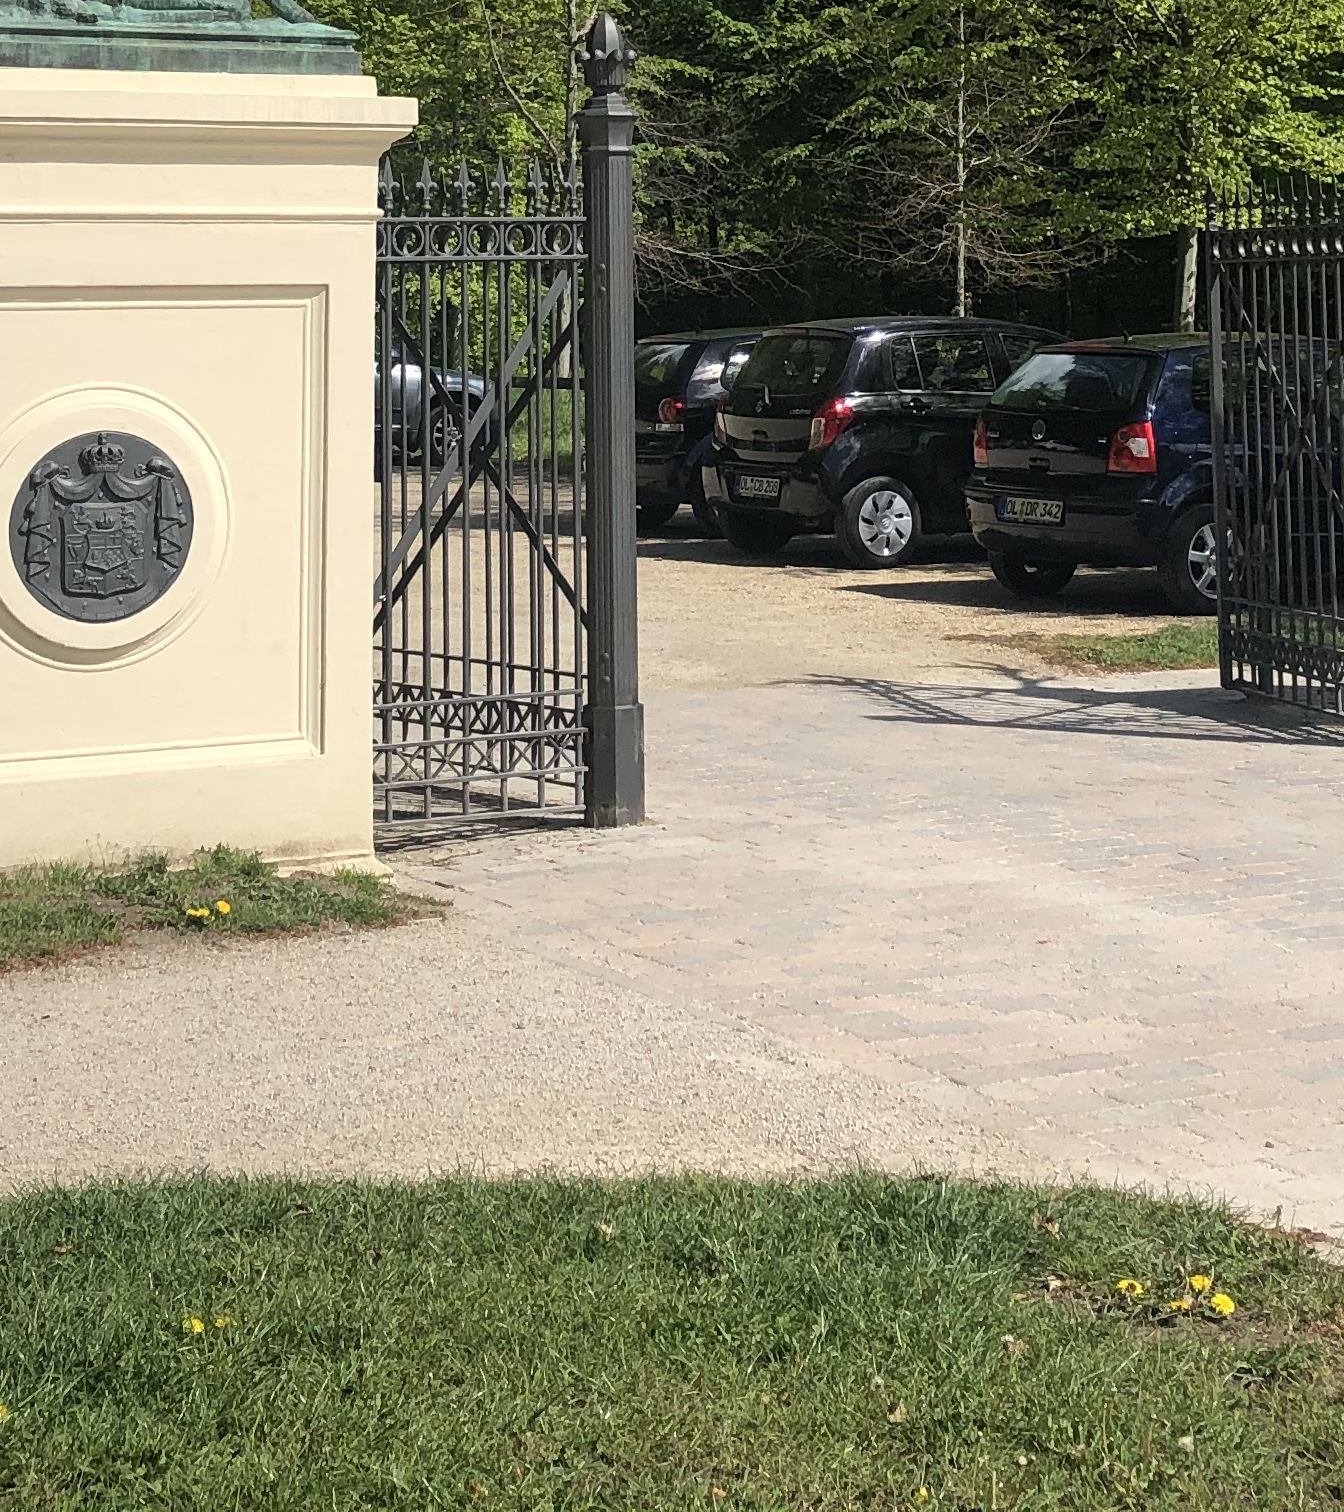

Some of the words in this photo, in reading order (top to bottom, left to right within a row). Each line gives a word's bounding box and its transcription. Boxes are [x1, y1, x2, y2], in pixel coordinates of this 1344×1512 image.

[1006, 500, 1018, 515] OL
[1025, 501, 1039, 517] DR
[1040, 503, 1061, 519] 342
